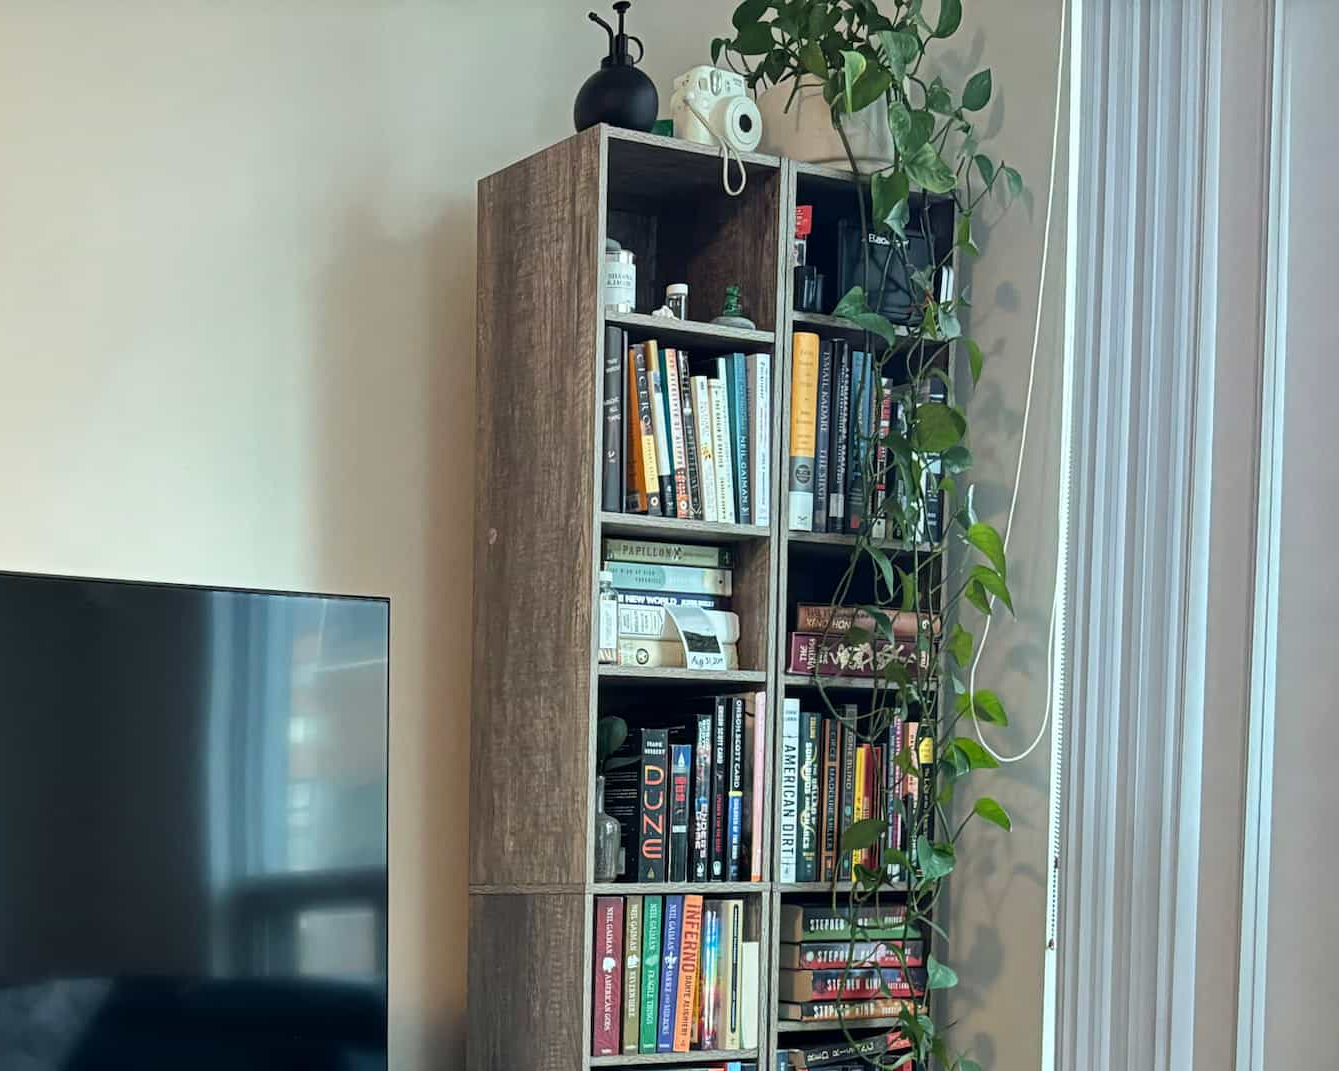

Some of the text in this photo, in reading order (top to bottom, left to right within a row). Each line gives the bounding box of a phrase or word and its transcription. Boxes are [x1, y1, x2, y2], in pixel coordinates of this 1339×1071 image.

[636, 354, 651, 426] CICERO
[820, 352, 830, 433] ISMAIL KADARE
[740, 435, 748, 459] NEIL
[818, 473, 827, 503] SIEGE
[622, 544, 672, 558] PAPILLON
[625, 594, 677, 606] NEW WORLD
[799, 645, 808, 662] THE
[782, 745, 797, 855] AMERICAN DIRT
[828, 768, 836, 816] MADELINE
[642, 765, 665, 859] DUNE
[605, 924, 613, 954] GAIMAN
[668, 921, 676, 951] GAIMAN
[681, 904, 701, 973] INFERNO
[809, 918, 845, 931] STEPHEN
[817, 949, 854, 963] STEPHE
[628, 971, 636, 1018] NEVERWHERE
[827, 978, 861, 991] STEHEN
[603, 974, 612, 1031] AMERICAN GODS
[646, 1000, 654, 1025] THINGS
[680, 976, 692, 1037] DANTE ALIGHIERI
[832, 1042, 874, 1057] RISNG
